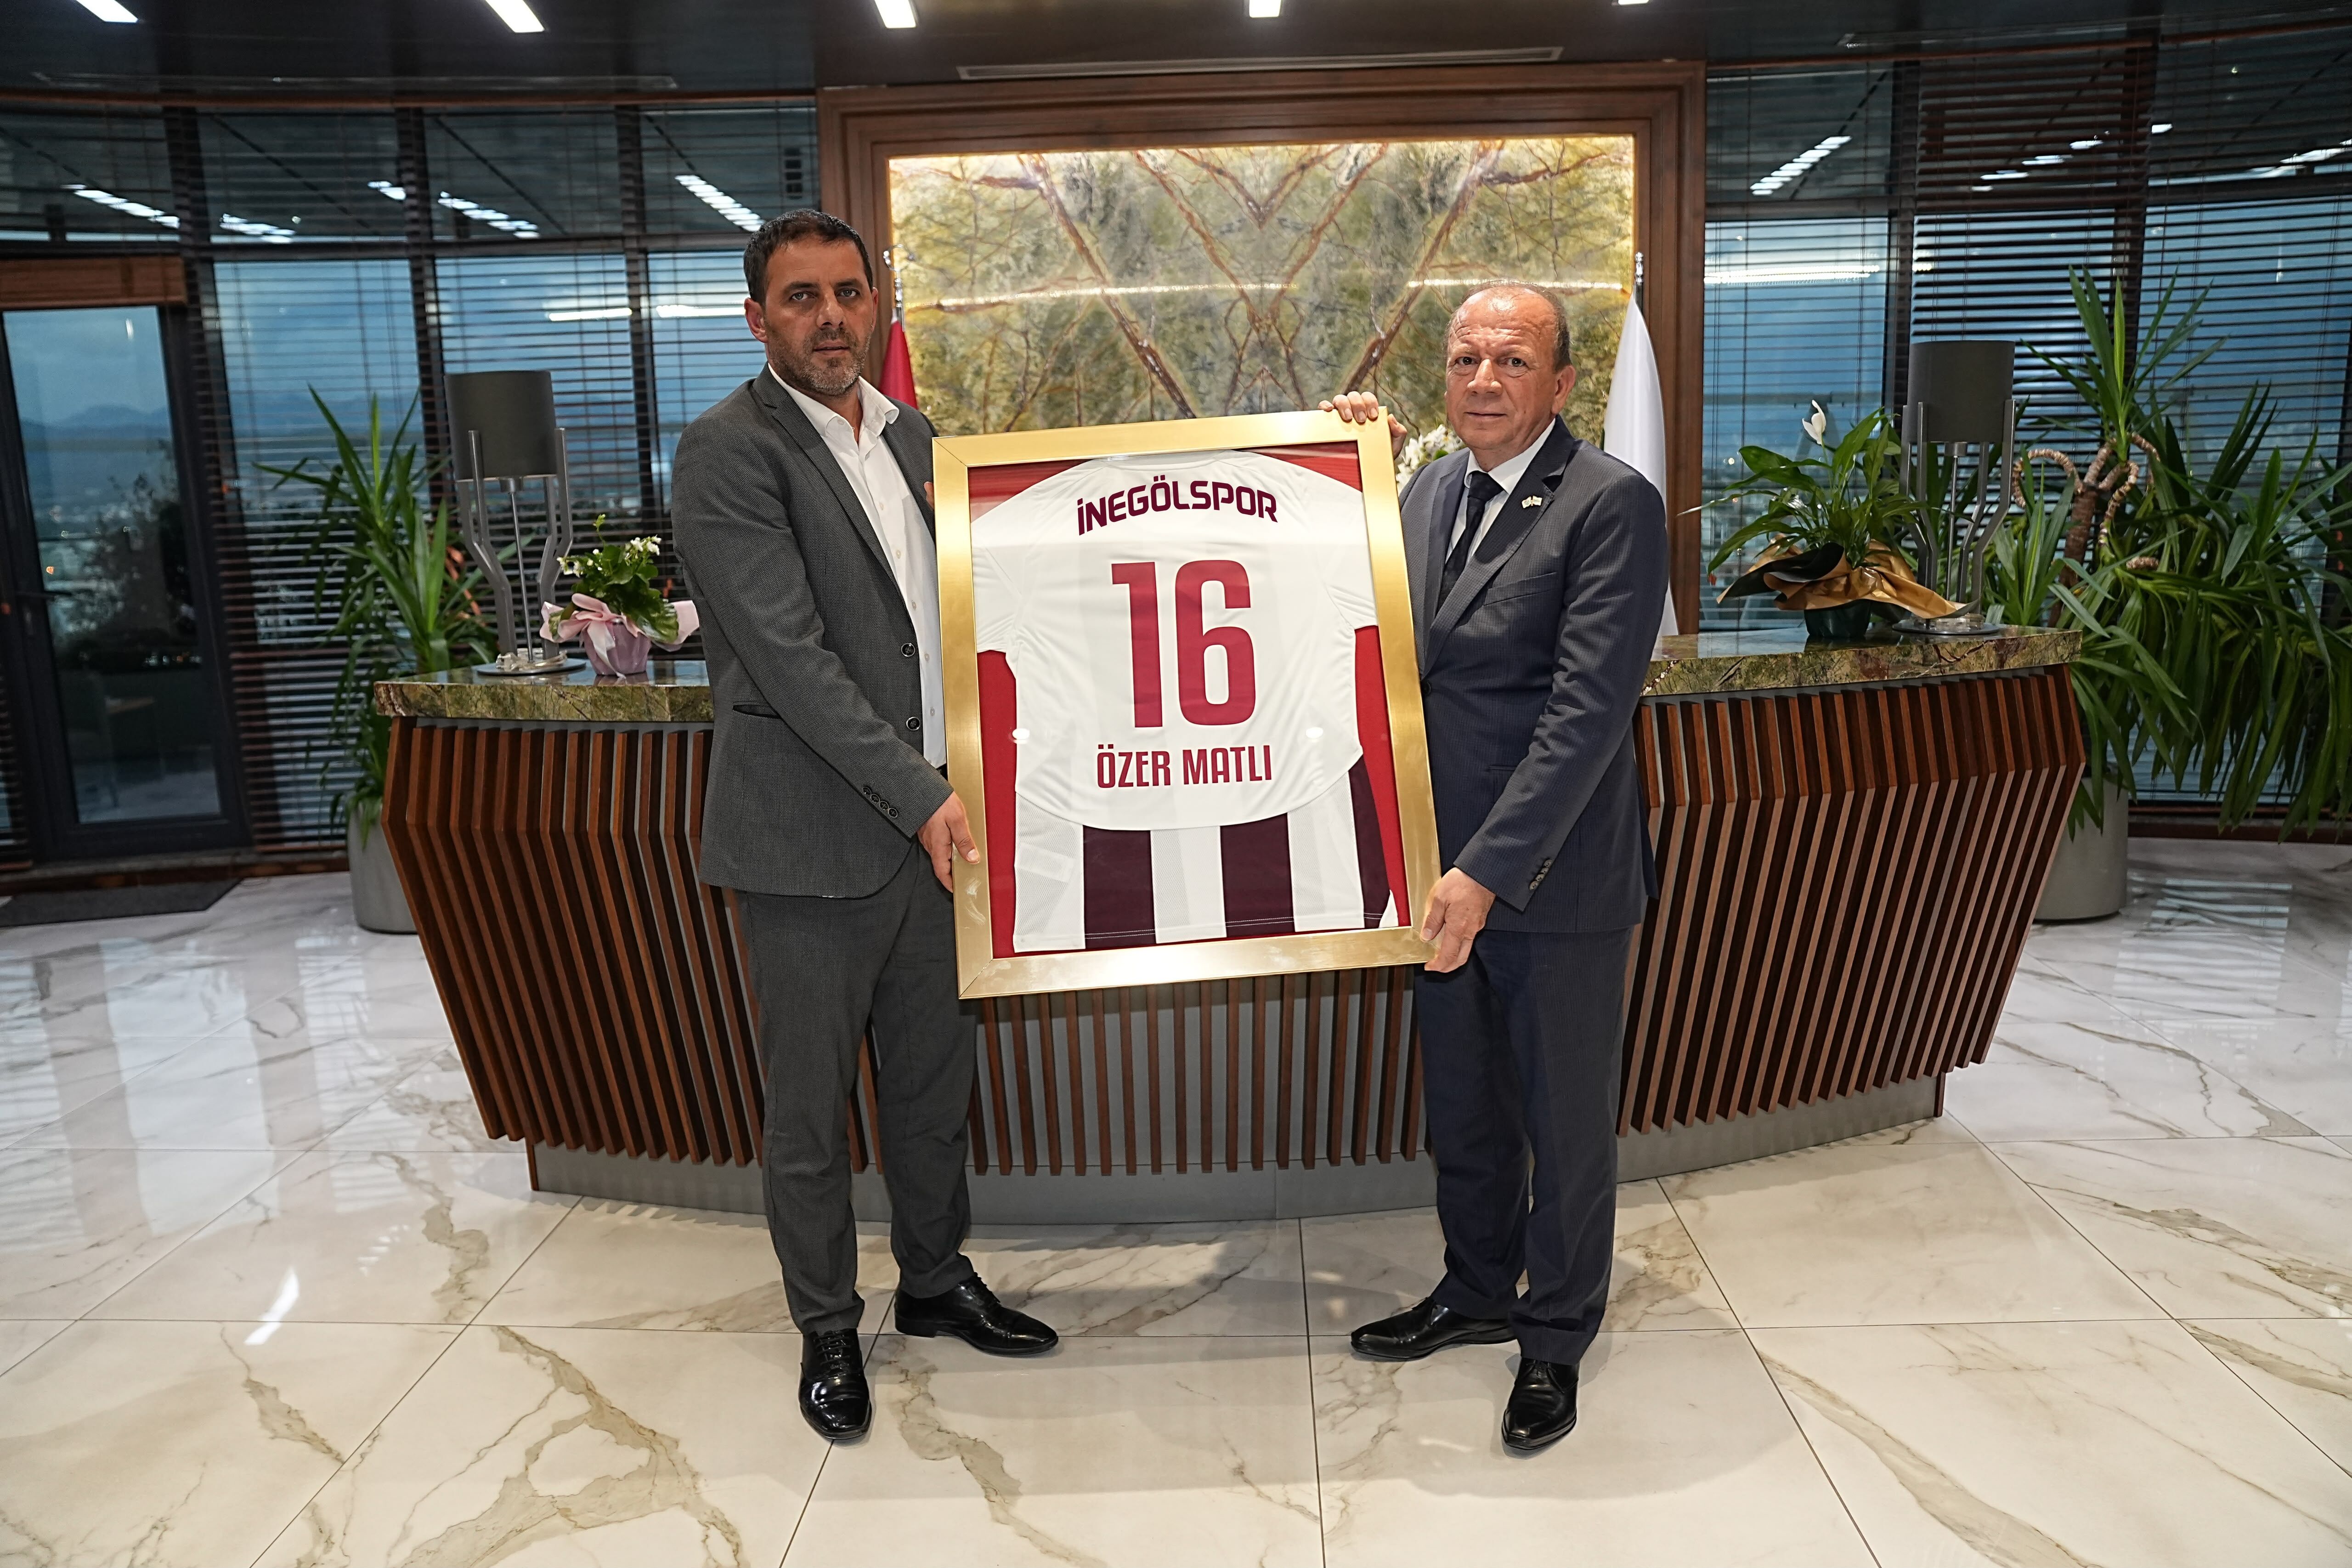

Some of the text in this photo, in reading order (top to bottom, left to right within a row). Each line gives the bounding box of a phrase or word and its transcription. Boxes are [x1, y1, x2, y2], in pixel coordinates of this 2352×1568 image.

[1077, 475, 1278, 536] İNEGÖLSPOR
[1112, 560, 1255, 727] 16
[1097, 744, 1272, 788] ÖZER MATLI
